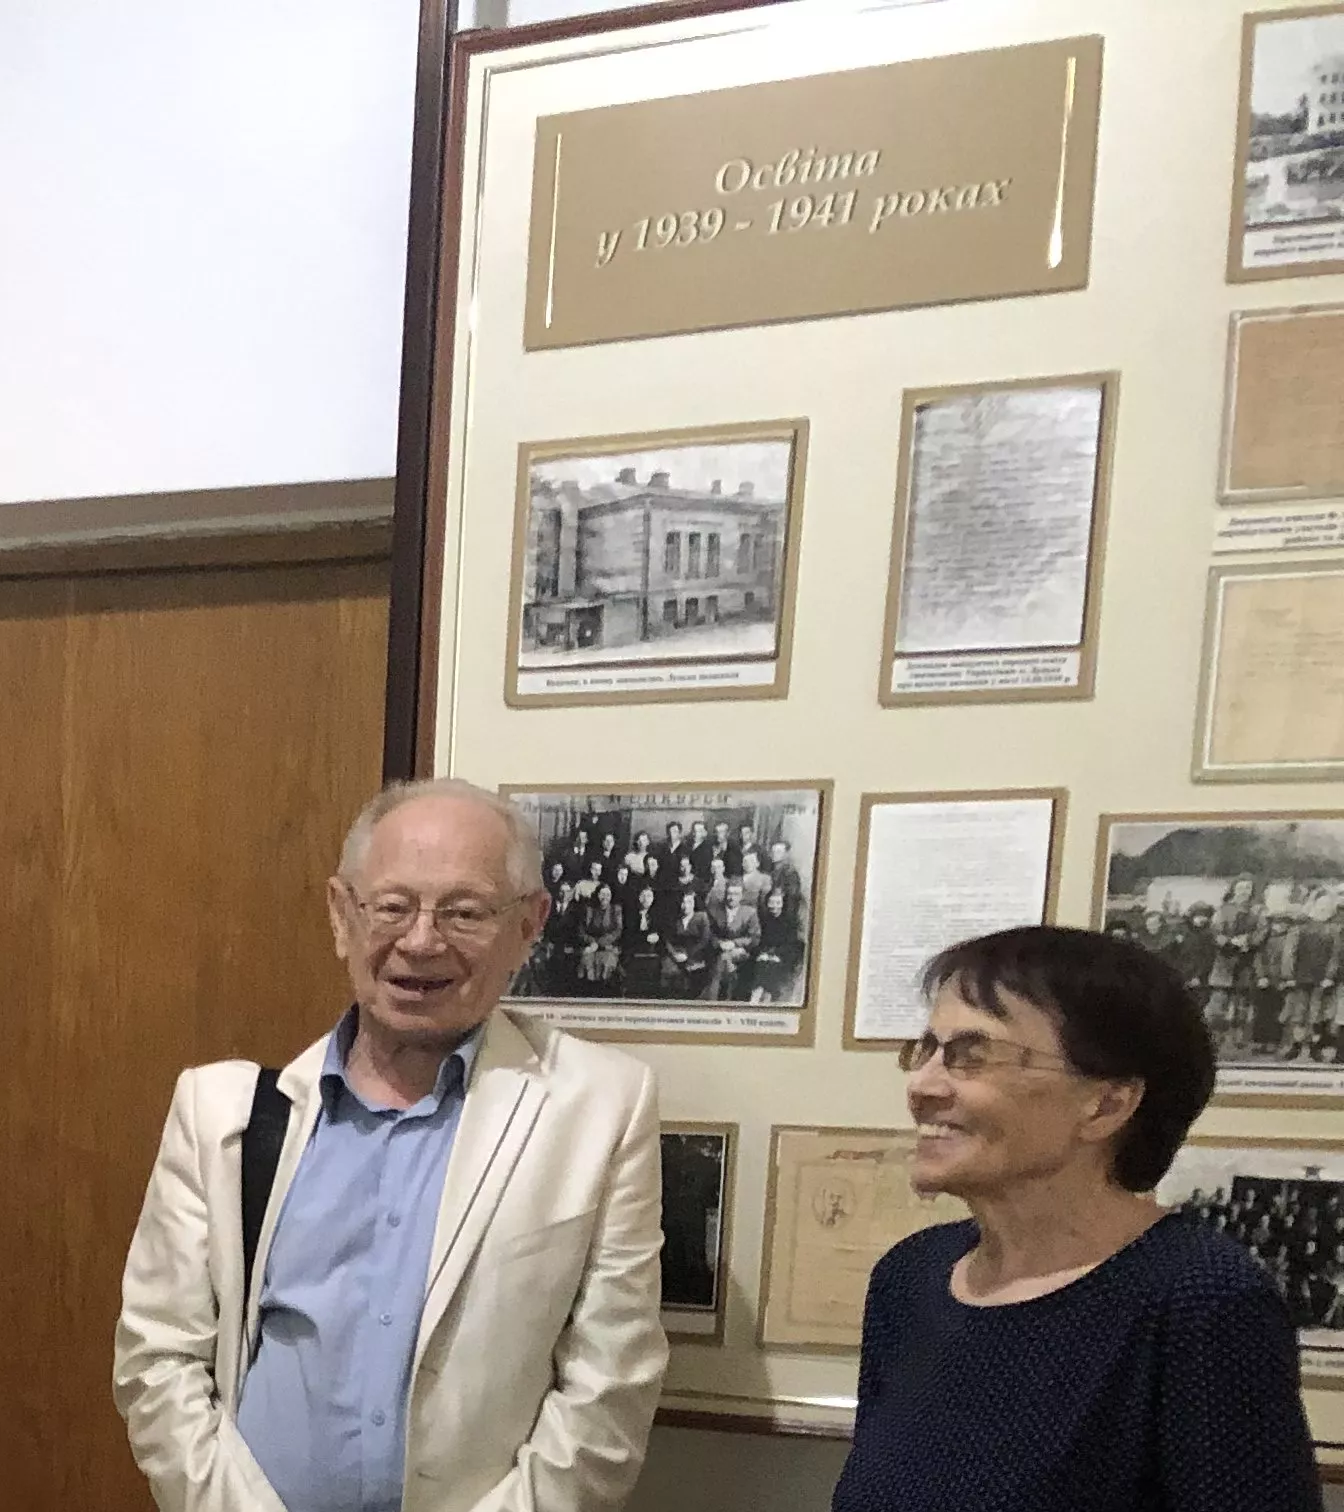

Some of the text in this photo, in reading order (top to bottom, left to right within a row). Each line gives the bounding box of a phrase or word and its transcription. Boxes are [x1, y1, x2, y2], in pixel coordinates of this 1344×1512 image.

[714, 146, 883, 195] Освіта
[593, 227, 623, 269] у
[632, 207, 727, 252] 1939
[767, 187, 860, 236] 1941
[868, 176, 1014, 234] роках
